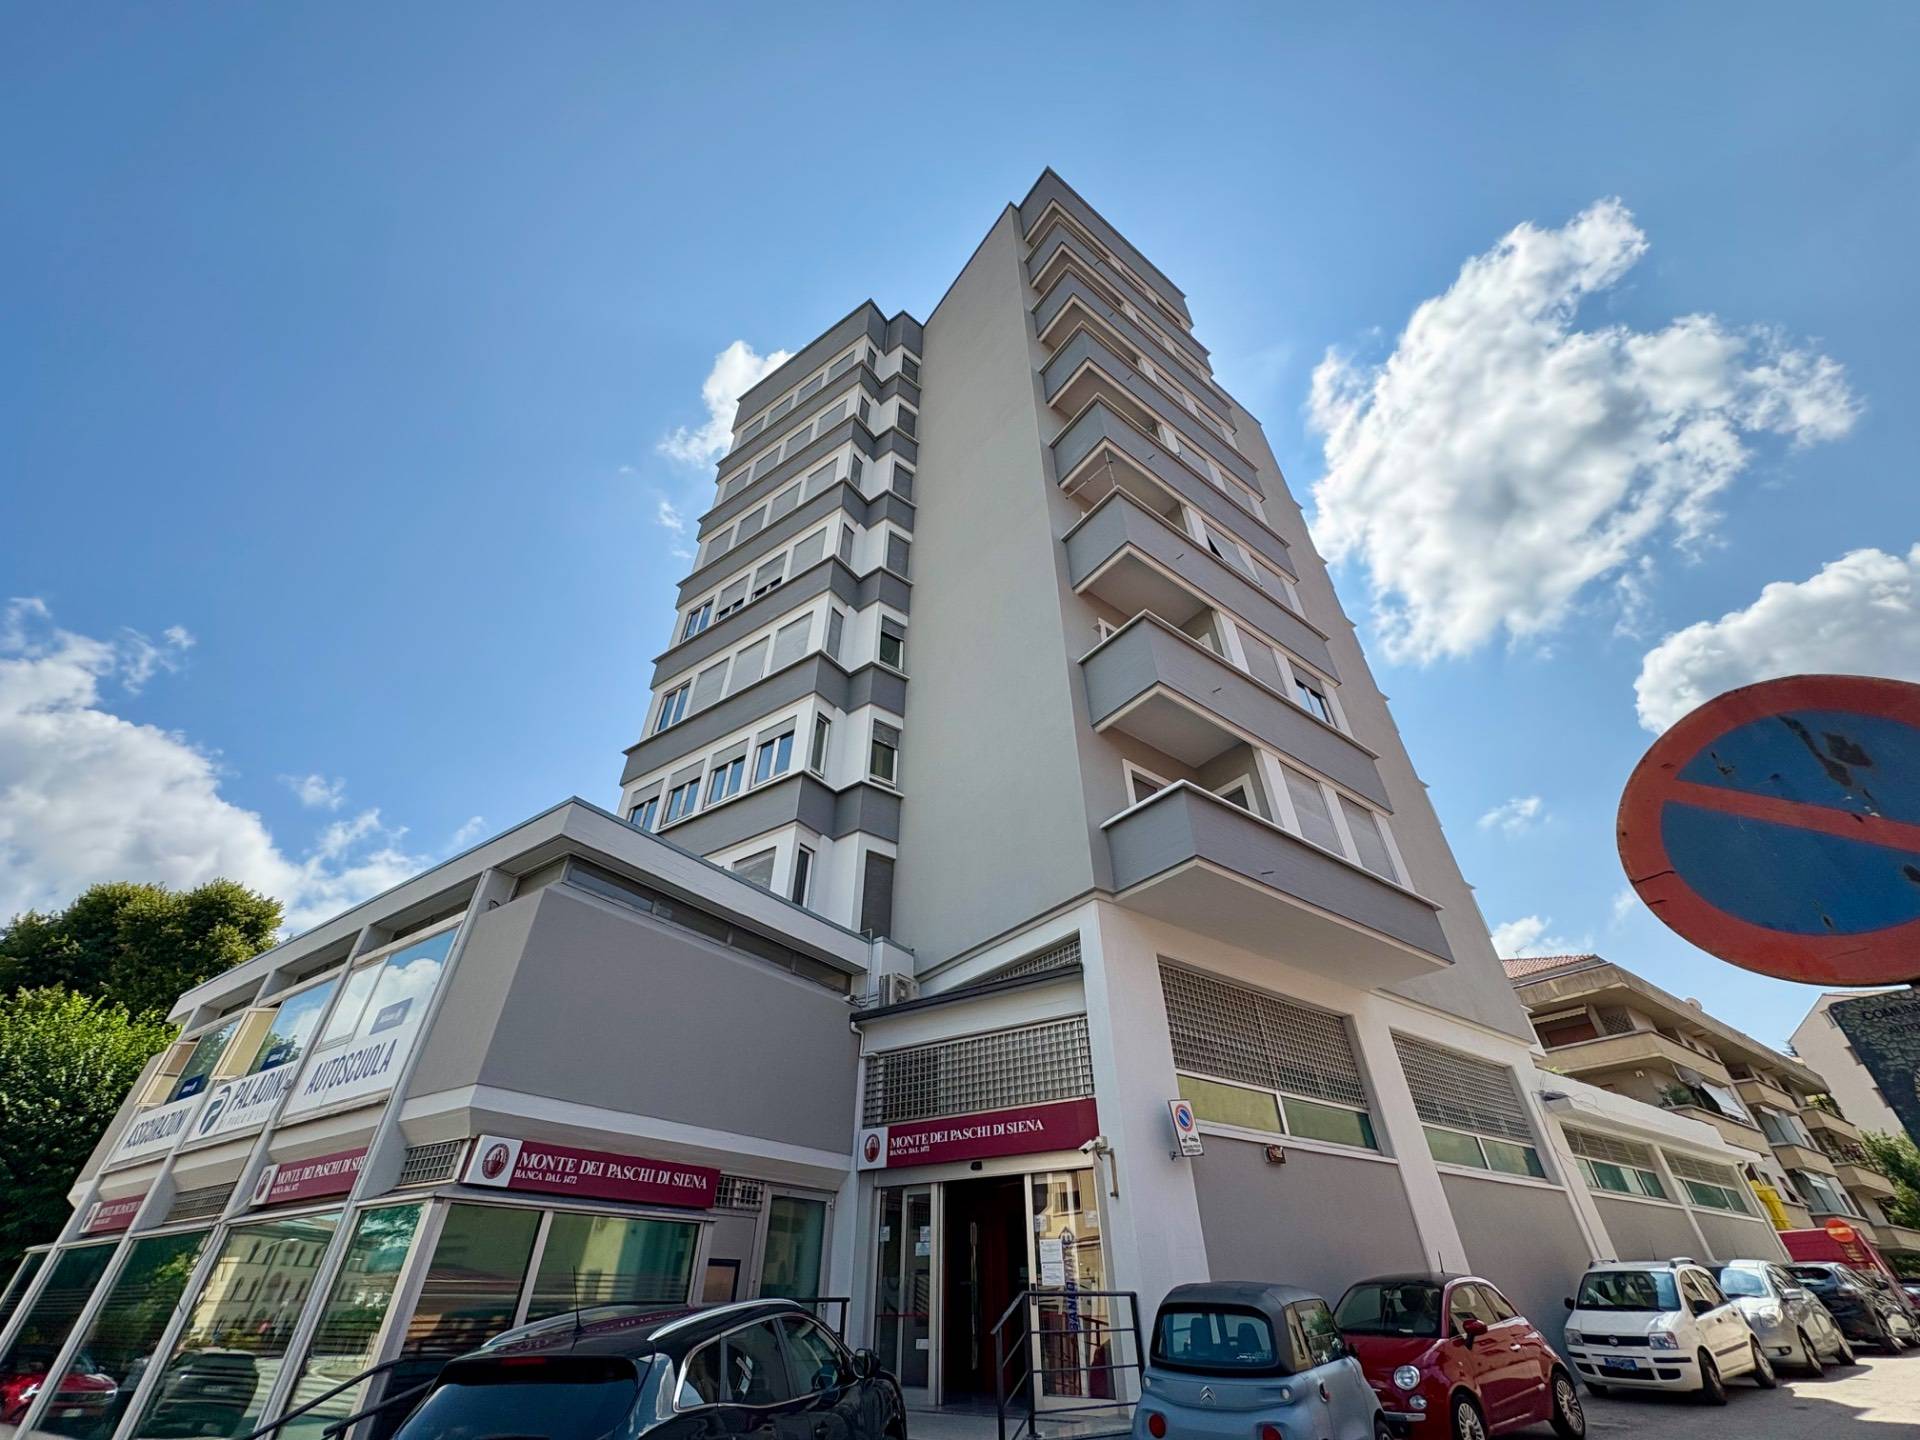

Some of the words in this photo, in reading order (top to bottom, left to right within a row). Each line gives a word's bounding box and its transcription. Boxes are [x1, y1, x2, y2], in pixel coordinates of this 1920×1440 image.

[304, 1038, 398, 1096] AUTOSCUOLA
[890, 1133, 929, 1149] MONTE
[930, 1131, 948, 1144] DEI
[950, 1126, 991, 1141] PASCHI
[993, 1124, 1005, 1136] DI
[1006, 1119, 1044, 1135] SIENA
[275, 1168, 302, 1185] MONTE
[314, 1160, 343, 1178] PASCHI
[514, 1169, 543, 1181] BANCA
[545, 1173, 562, 1183] DAL
[518, 1151, 577, 1173] MONTE
[578, 1159, 604, 1177] DEI
[606, 1163, 654, 1183] PASCHI
[656, 1170, 670, 1185] DI
[672, 1172, 707, 1190] SIENA
